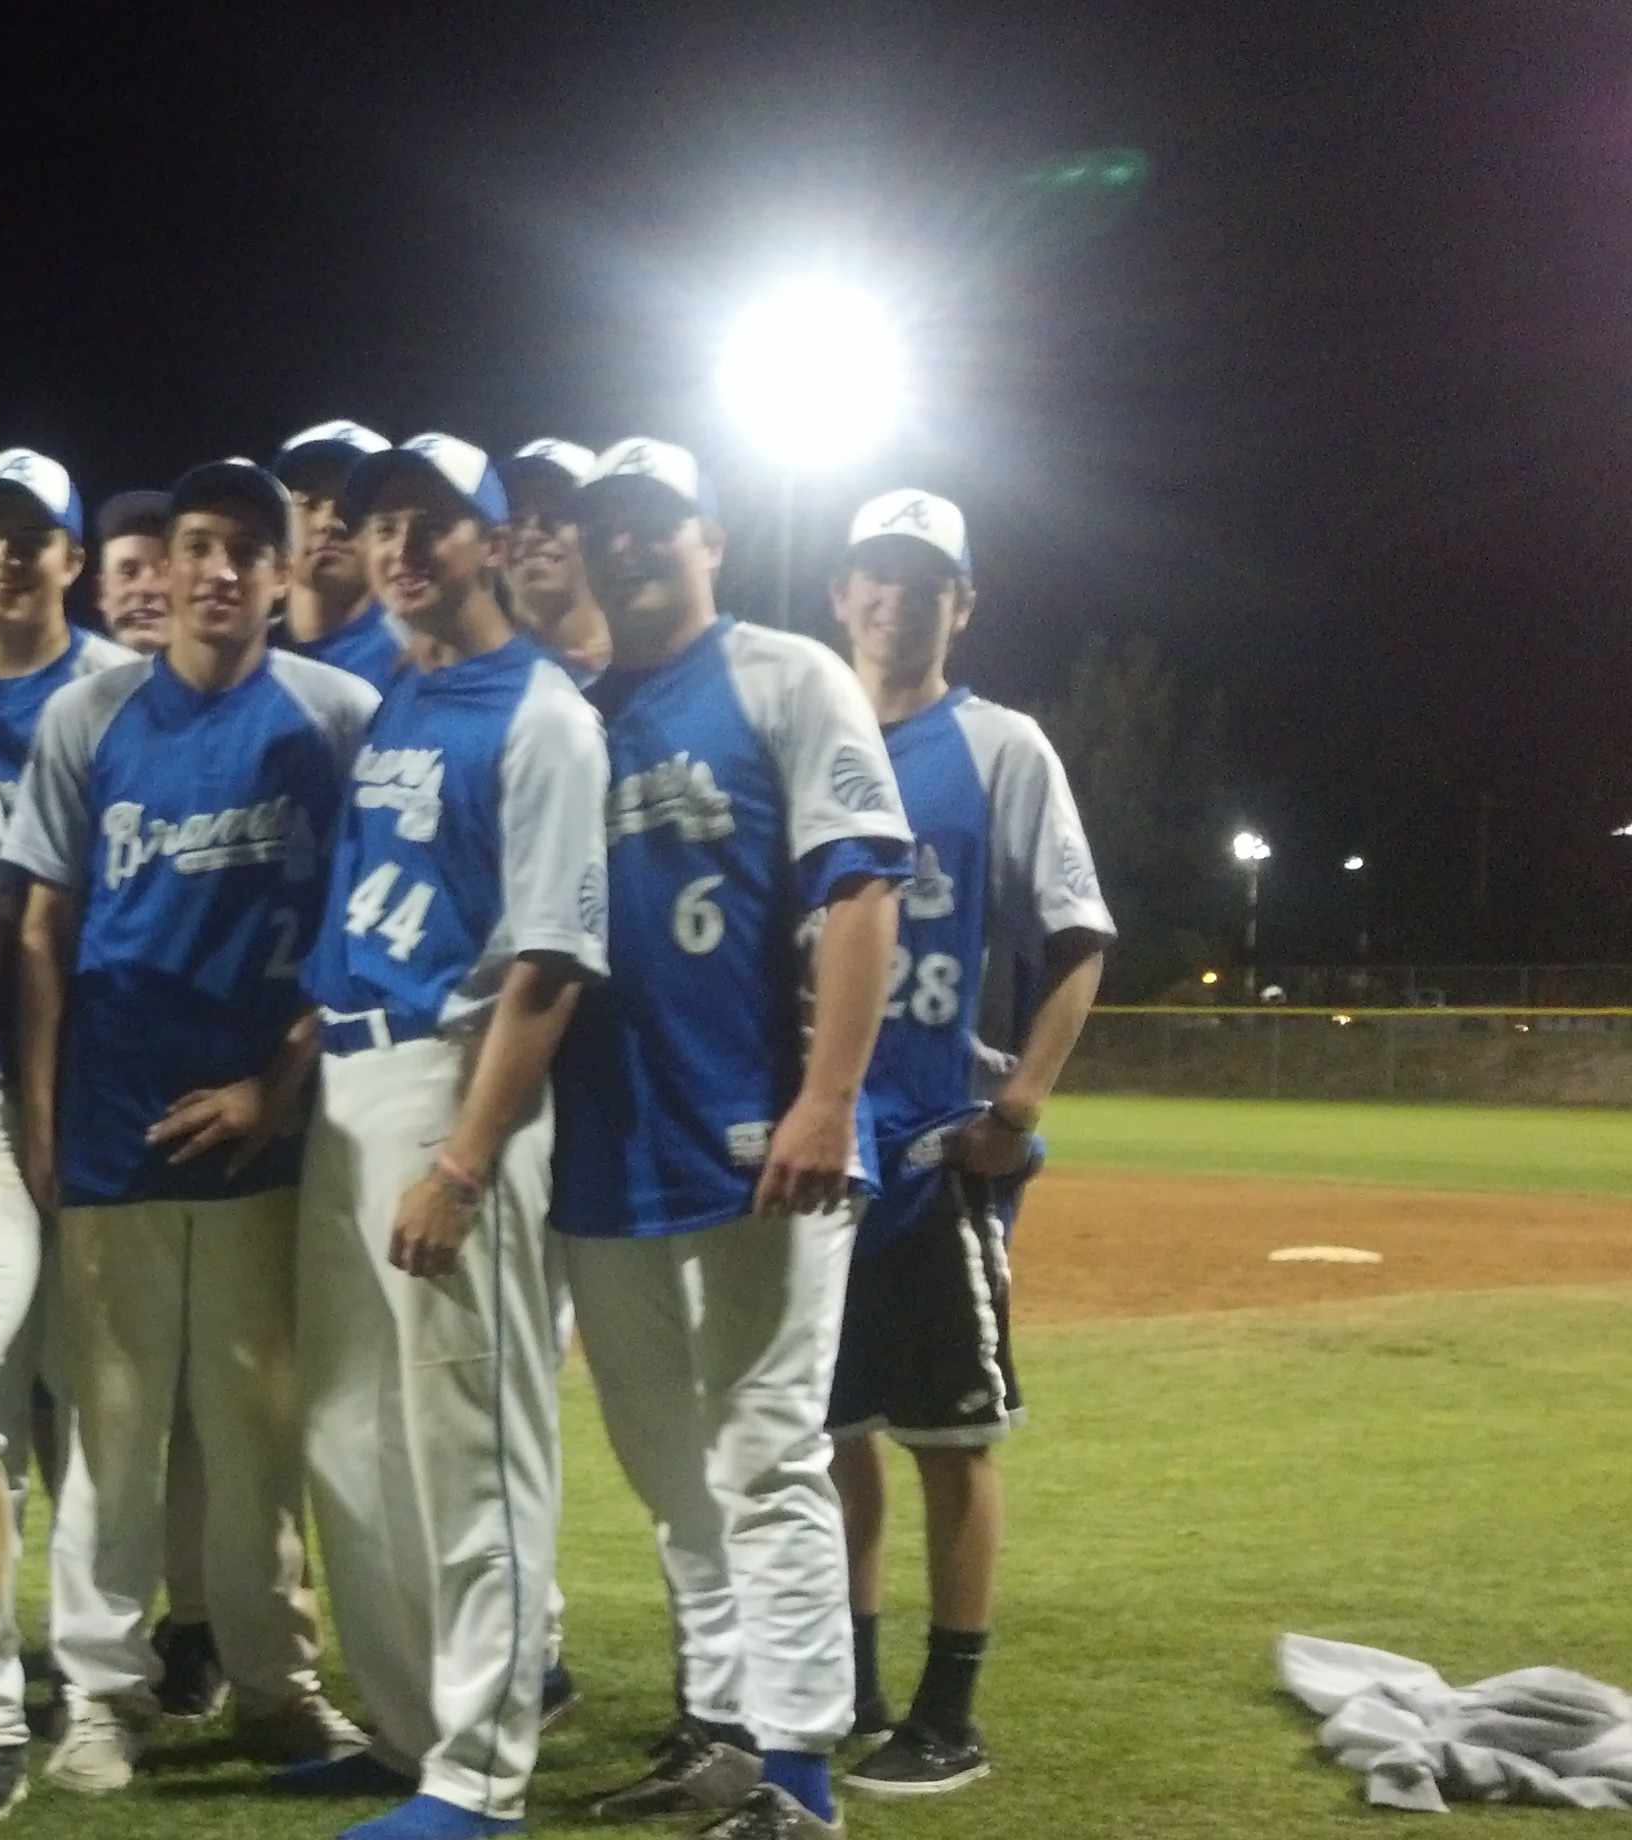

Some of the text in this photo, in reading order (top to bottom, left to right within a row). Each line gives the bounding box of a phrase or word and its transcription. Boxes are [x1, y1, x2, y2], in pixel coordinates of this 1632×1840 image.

[878, 498, 930, 532] A
[344, 862, 437, 961] 44
[673, 874, 726, 955] 6
[882, 944, 962, 1026] 28
